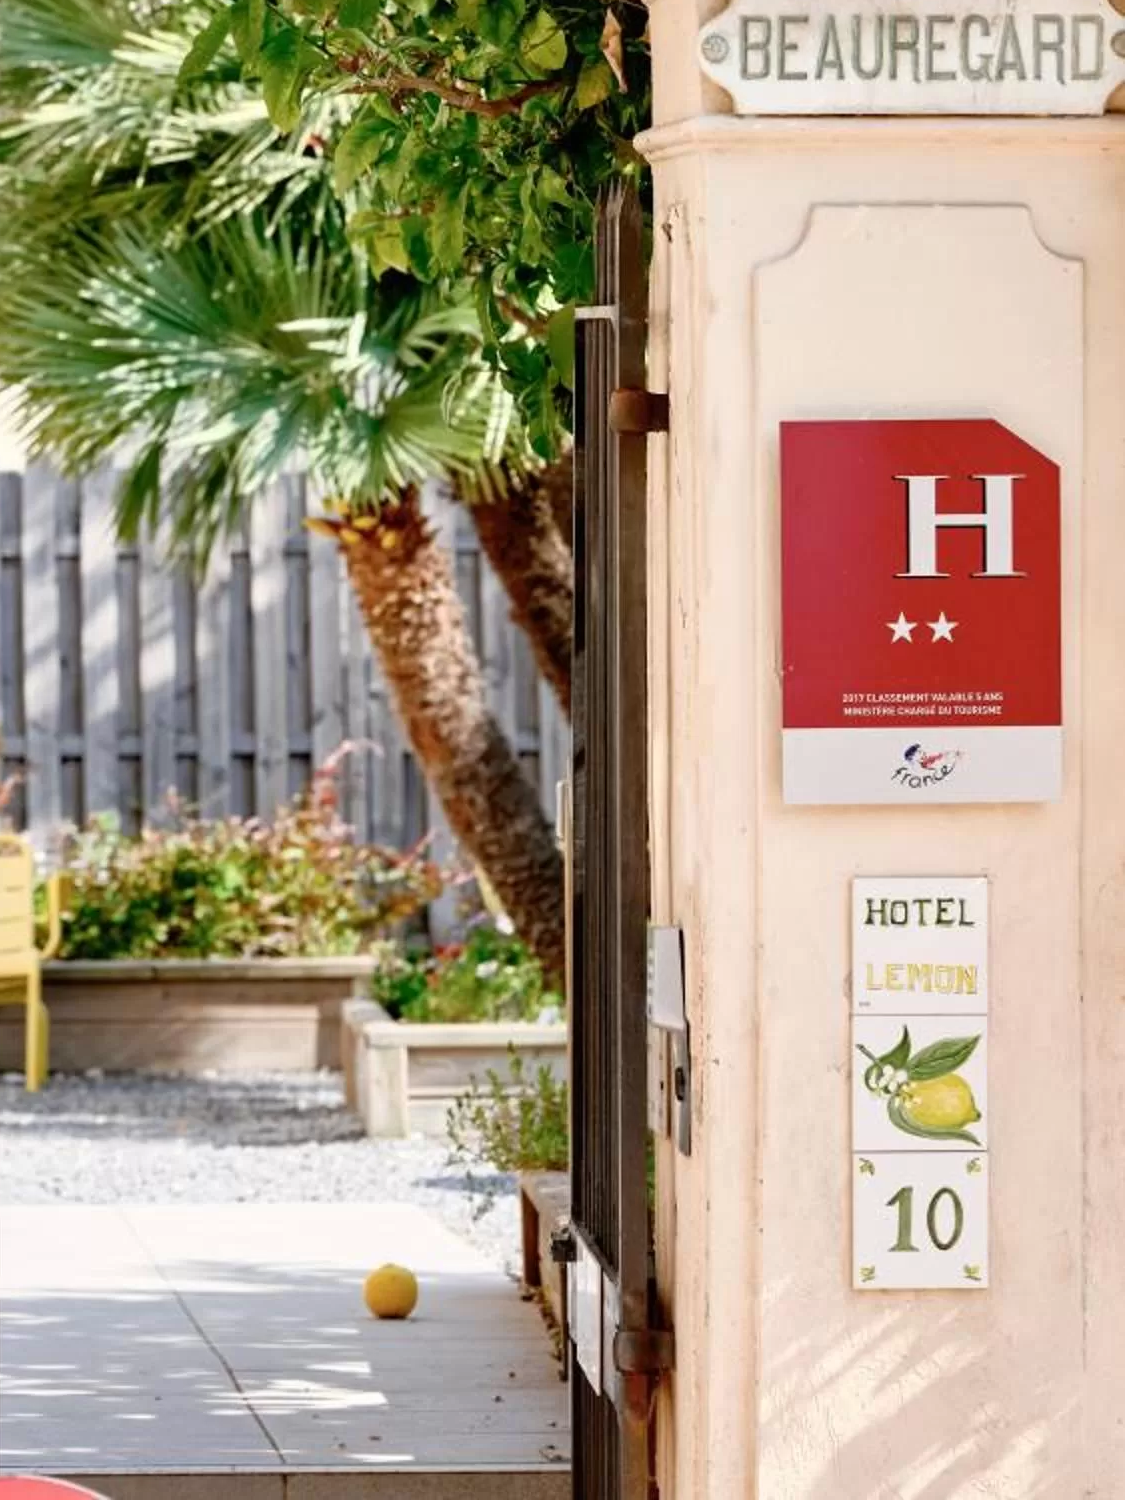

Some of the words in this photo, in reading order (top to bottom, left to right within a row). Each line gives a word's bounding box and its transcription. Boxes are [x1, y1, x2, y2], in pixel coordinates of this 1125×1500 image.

[738, 13, 1105, 85] BEAUREGARD
[892, 474, 1028, 578] H
[864, 897, 976, 927] HOTEL
[865, 963, 978, 995] LEMON
[886, 1185, 964, 1252] 10
